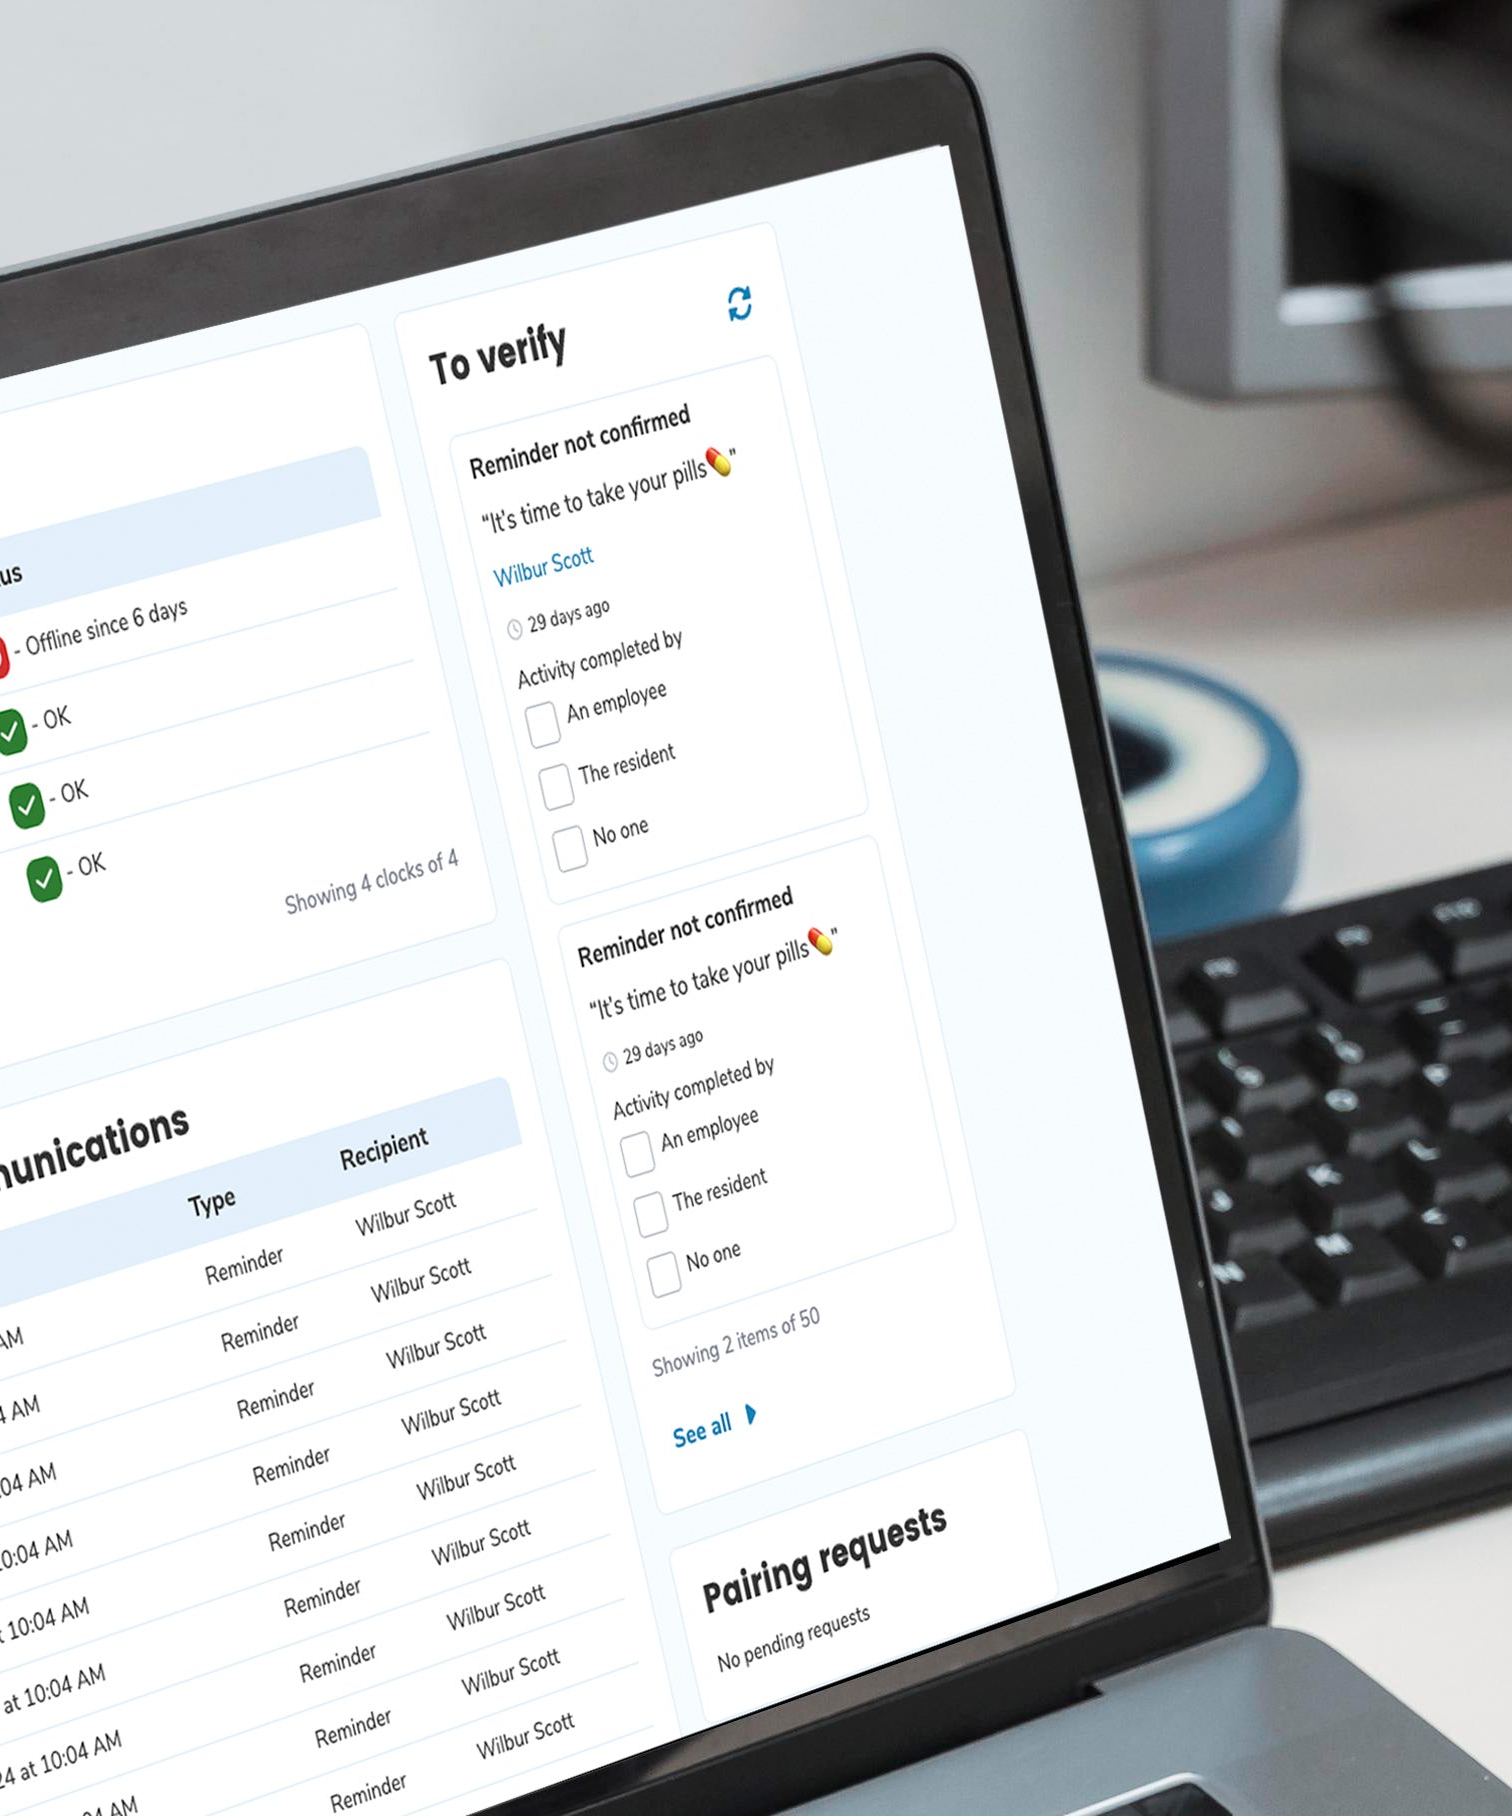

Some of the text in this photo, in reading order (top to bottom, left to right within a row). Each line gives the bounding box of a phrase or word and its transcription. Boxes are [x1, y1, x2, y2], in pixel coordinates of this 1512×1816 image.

[429, 323, 565, 384] To verify
[470, 403, 690, 478] Reminder not confirmed
[521, 502, 560, 524] time
[564, 495, 582, 512] to
[587, 483, 625, 507] take
[628, 472, 667, 500] your
[493, 547, 594, 586] Wilbur Scott
[26, 601, 187, 655] Offline since 6 days
[528, 601, 609, 632] 29 days ago
[519, 631, 682, 689] Activity completed by
[44, 705, 71, 729] OK
[568, 684, 666, 722] An employee
[578, 744, 676, 783] The resident
[61, 778, 89, 802] OK
[593, 820, 648, 846] No one
[78, 851, 106, 875] OK
[285, 849, 458, 914] Showing 4 clocks of 4
[578, 886, 793, 967] Reminder not confirmed
[627, 987, 666, 1009] time
[670, 980, 688, 996] to
[692, 966, 729, 990] take
[732, 954, 770, 982] your
[624, 1031, 703, 1064] 29 days ago
[614, 1058, 773, 1120] Activity completed by
[340, 1128, 429, 1170] Recipient
[662, 1110, 759, 1151] An employee
[188, 1191, 235, 1218] Type
[672, 1169, 767, 1210] The resident
[355, 1192, 457, 1236] Wilbur Scott
[205, 1249, 282, 1284] Reminder
[687, 1244, 740, 1271] No one
[652, 1306, 820, 1377] Showing 2 items of 50
[673, 1412, 731, 1447] See all
[703, 1509, 946, 1613] Pairing requests
[718, 1608, 870, 1672] No pending requests
[476, 1713, 575, 1758] Wilbur Scott
[331, 1775, 405, 1813] Reminder
